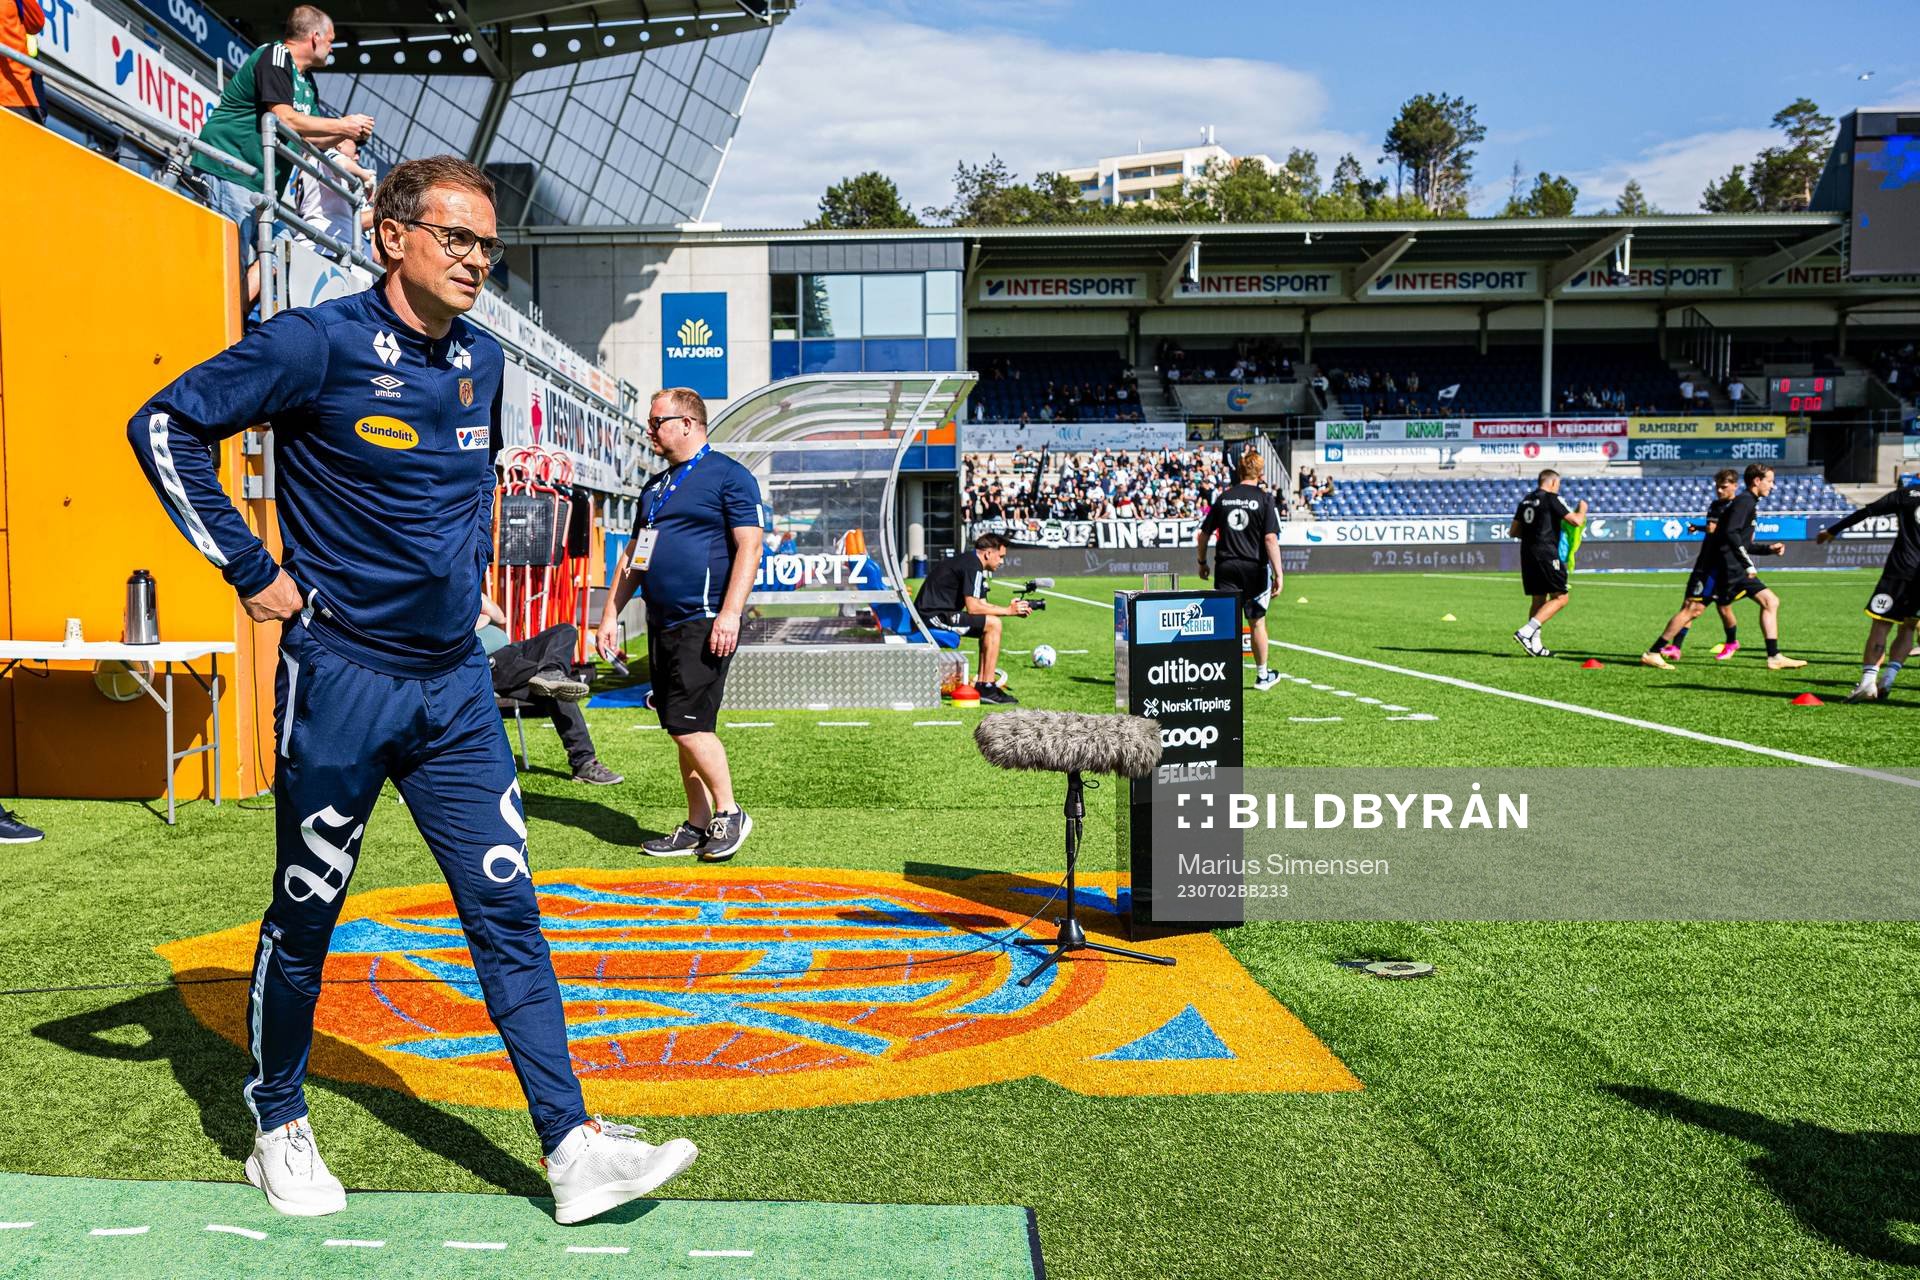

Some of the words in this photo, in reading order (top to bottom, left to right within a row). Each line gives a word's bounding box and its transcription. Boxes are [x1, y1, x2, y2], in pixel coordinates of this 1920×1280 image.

[1006, 278, 1137, 295] INTERSPORT
[1200, 275, 1331, 293] INTERSPORT
[1395, 271, 1527, 290] INTERSPORT
[666, 347, 723, 358] TAFJORD
[375, 389, 402, 399] umbro
[1791, 396, 1822, 411] 0:00
[361, 422, 413, 443] Sundolitt
[1327, 421, 1364, 439] KIWI
[1406, 421, 1443, 439] KIWI
[1479, 424, 1543, 434] VEIDEKKE
[1556, 423, 1621, 434] VEIDEKKE
[1639, 422, 1698, 433] RAMIRENT
[1715, 422, 1775, 433] RAMIRENT
[1634, 444, 1681, 460] SPERRE
[1731, 443, 1779, 459] SPERRE
[1161, 612, 1186, 628] ELITE
[1184, 619, 1212, 633] SERIEN
[1148, 657, 1226, 685] altibox
[1161, 699, 1192, 713] Norsk
[1193, 697, 1231, 713] Tipping
[1160, 725, 1219, 749] coop
[1158, 760, 1217, 785] SELECT
